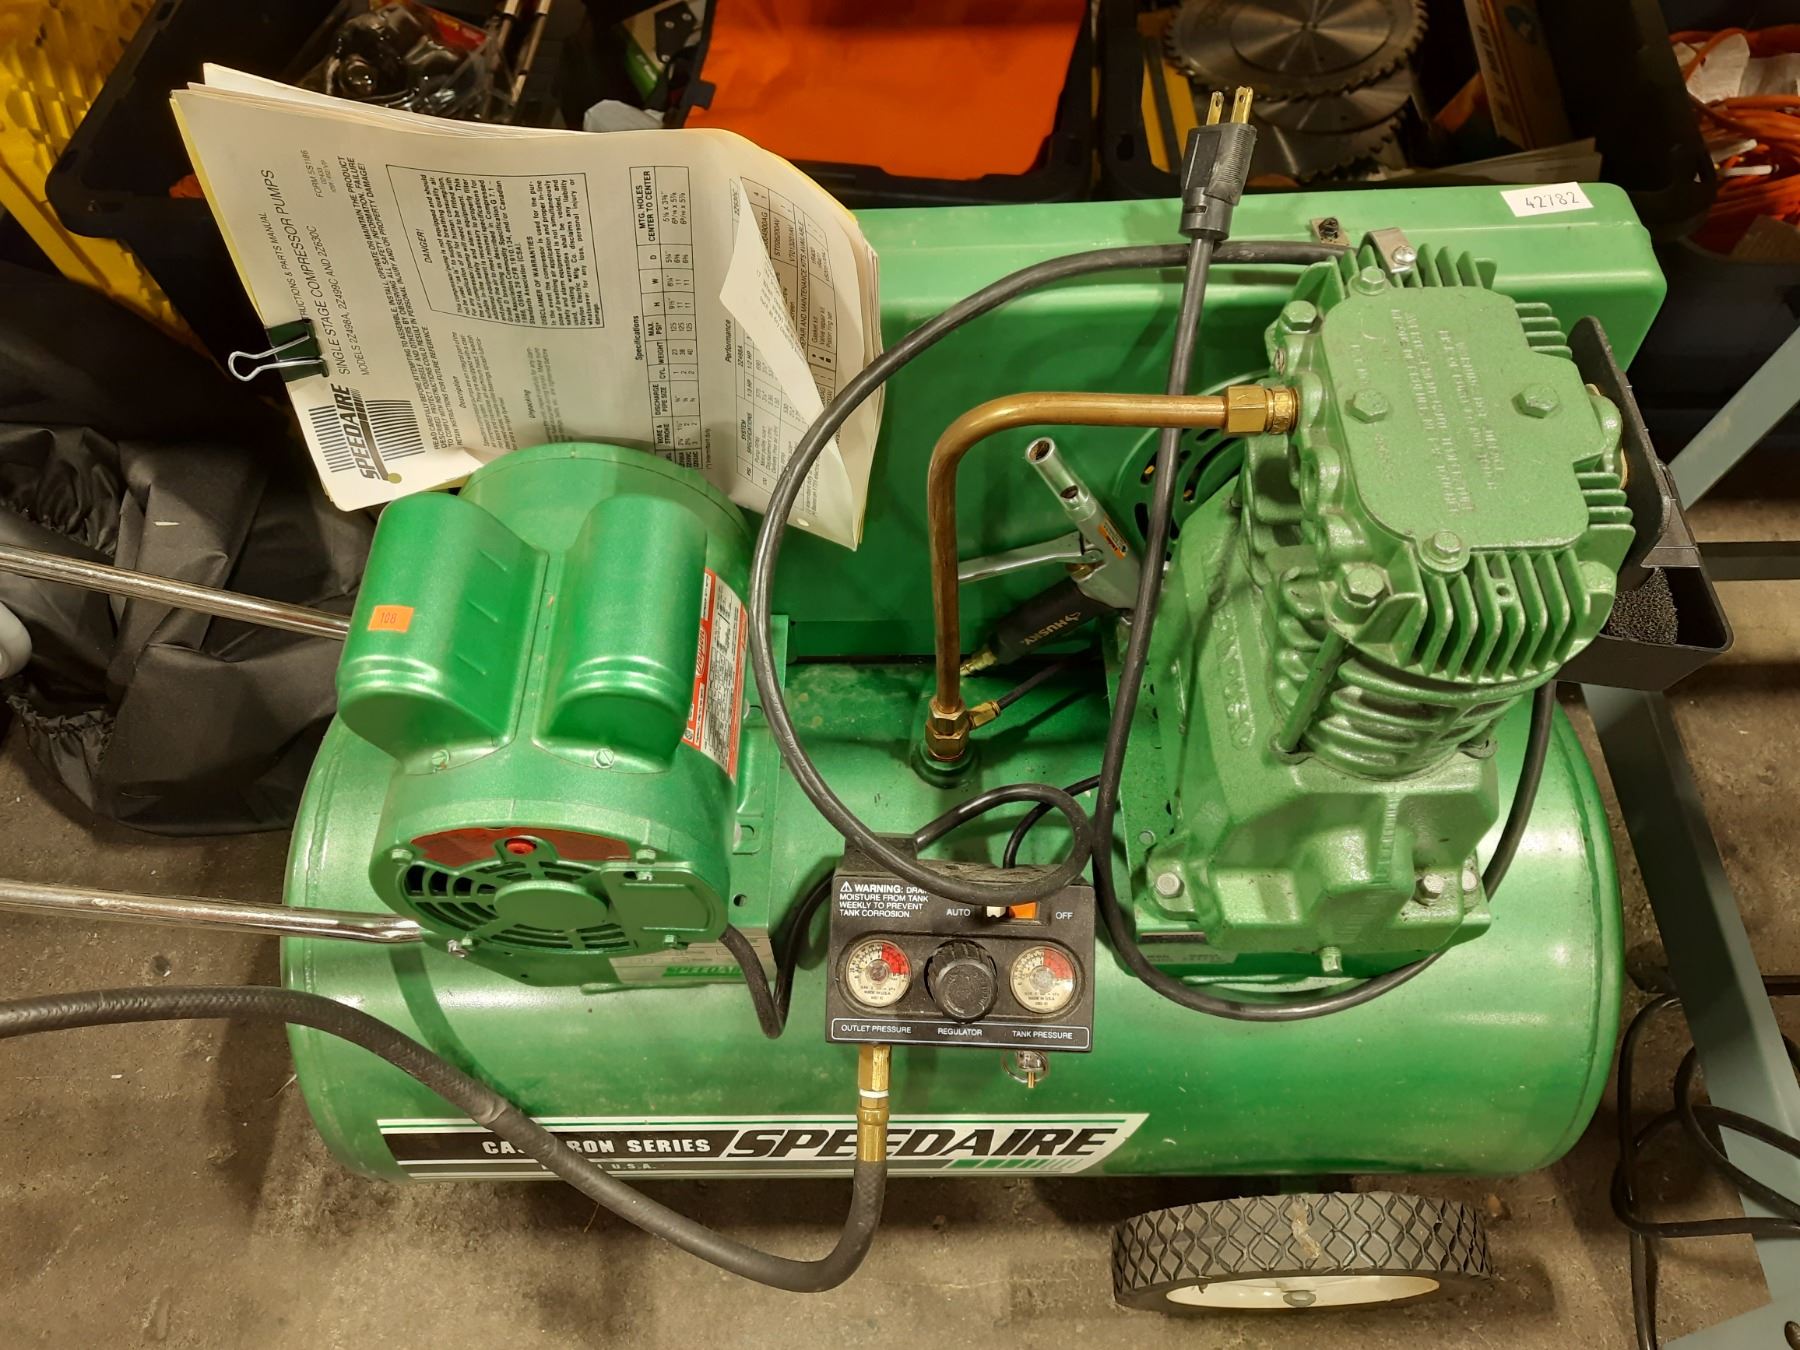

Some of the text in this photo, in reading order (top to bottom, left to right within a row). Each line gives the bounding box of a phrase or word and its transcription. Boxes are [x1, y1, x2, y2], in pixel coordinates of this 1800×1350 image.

[337, 156, 355, 193] PRODUCT
[347, 157, 362, 189] FAILURE
[358, 164, 374, 198] DAMAGE!
[446, 177, 454, 190] with
[470, 179, 478, 189] for
[311, 177, 324, 197] FORM
[420, 175, 431, 195] should
[454, 179, 462, 191] This
[495, 181, 506, 210] Canadian
[528, 181, 537, 194] pur-
[561, 180, 569, 202] liability
[349, 194, 360, 208] THE
[427, 197, 436, 208] and
[449, 192, 458, 209] fitted
[462, 179, 476, 220] properly filter
[479, 180, 493, 219] Compressed
[544, 180, 557, 227] simultaneously
[570, 191, 579, 209] injury
[644, 171, 656, 241] CENTER TO CENTER
[258, 212, 278, 243] MANUAL
[355, 209, 371, 240] MAINTAIN
[369, 199, 386, 235] PROPERTY
[430, 210, 442, 237] equipped
[432, 188, 455, 258] supply breathing quality
[534, 221, 542, 236] used
[539, 202, 550, 235] and proper
[573, 214, 583, 242] personal
[449, 220, 458, 239] human
[367, 241, 375, 250] OR
[376, 241, 388, 264] SAFETY
[416, 229, 432, 263] DANGER!
[494, 206, 514, 279] Commodity Specification
[273, 246, 289, 269] PARTS
[321, 259, 335, 276] AND
[372, 250, 386, 279] OPERATE
[526, 236, 539, 277] WARRANTIES
[538, 246, 549, 279] compressor
[261, 170, 350, 374] SINGLE STAGE COMPRESSOR PUMPS
[385, 268, 393, 279] ALL
[391, 264, 402, 284] INJURY
[285, 278, 310, 319] TRUCTIONS
[388, 281, 406, 315] OBSERVING
[400, 286, 417, 317] PERSONAL
[537, 290, 548, 325] DISCLAIMER
[399, 317, 409, 325] BY
[405, 326, 417, 349] OTHERS
[411, 326, 423, 346] RESULT
[633, 316, 642, 360] Specifications
[351, 345, 370, 375] MODELS
[403, 349, 419, 381] ATTEMPTING
[412, 350, 421, 361] AND
[419, 348, 430, 366] COULD
[418, 364, 430, 389] YOURSELF
[426, 367, 442, 405] INSTRUCTIONS
[415, 382, 426, 402] BEFORE
[426, 391, 437, 414] PROTECT
[431, 360, 457, 427] INSTRUCTIONS FOR FUTURE
[422, 403, 436, 431] CAREFULLY
[438, 405, 446, 416] WITH
[331, 384, 379, 479] SPEEDAIRE
[441, 418, 452, 437] COMPLY
[431, 432, 440, 449] READ
[855, 884, 903, 893] WARNING:
[886, 902, 923, 910] PREVENT
[946, 909, 970, 917] AUTO
[1056, 912, 1073, 920] OFF
[872, 1025, 911, 1034] PRESSURE
[938, 1028, 982, 1036] REGULATOR
[1033, 1031, 1072, 1039] PRESSURE
[482, 1139, 710, 1154] CA RON SERIES
